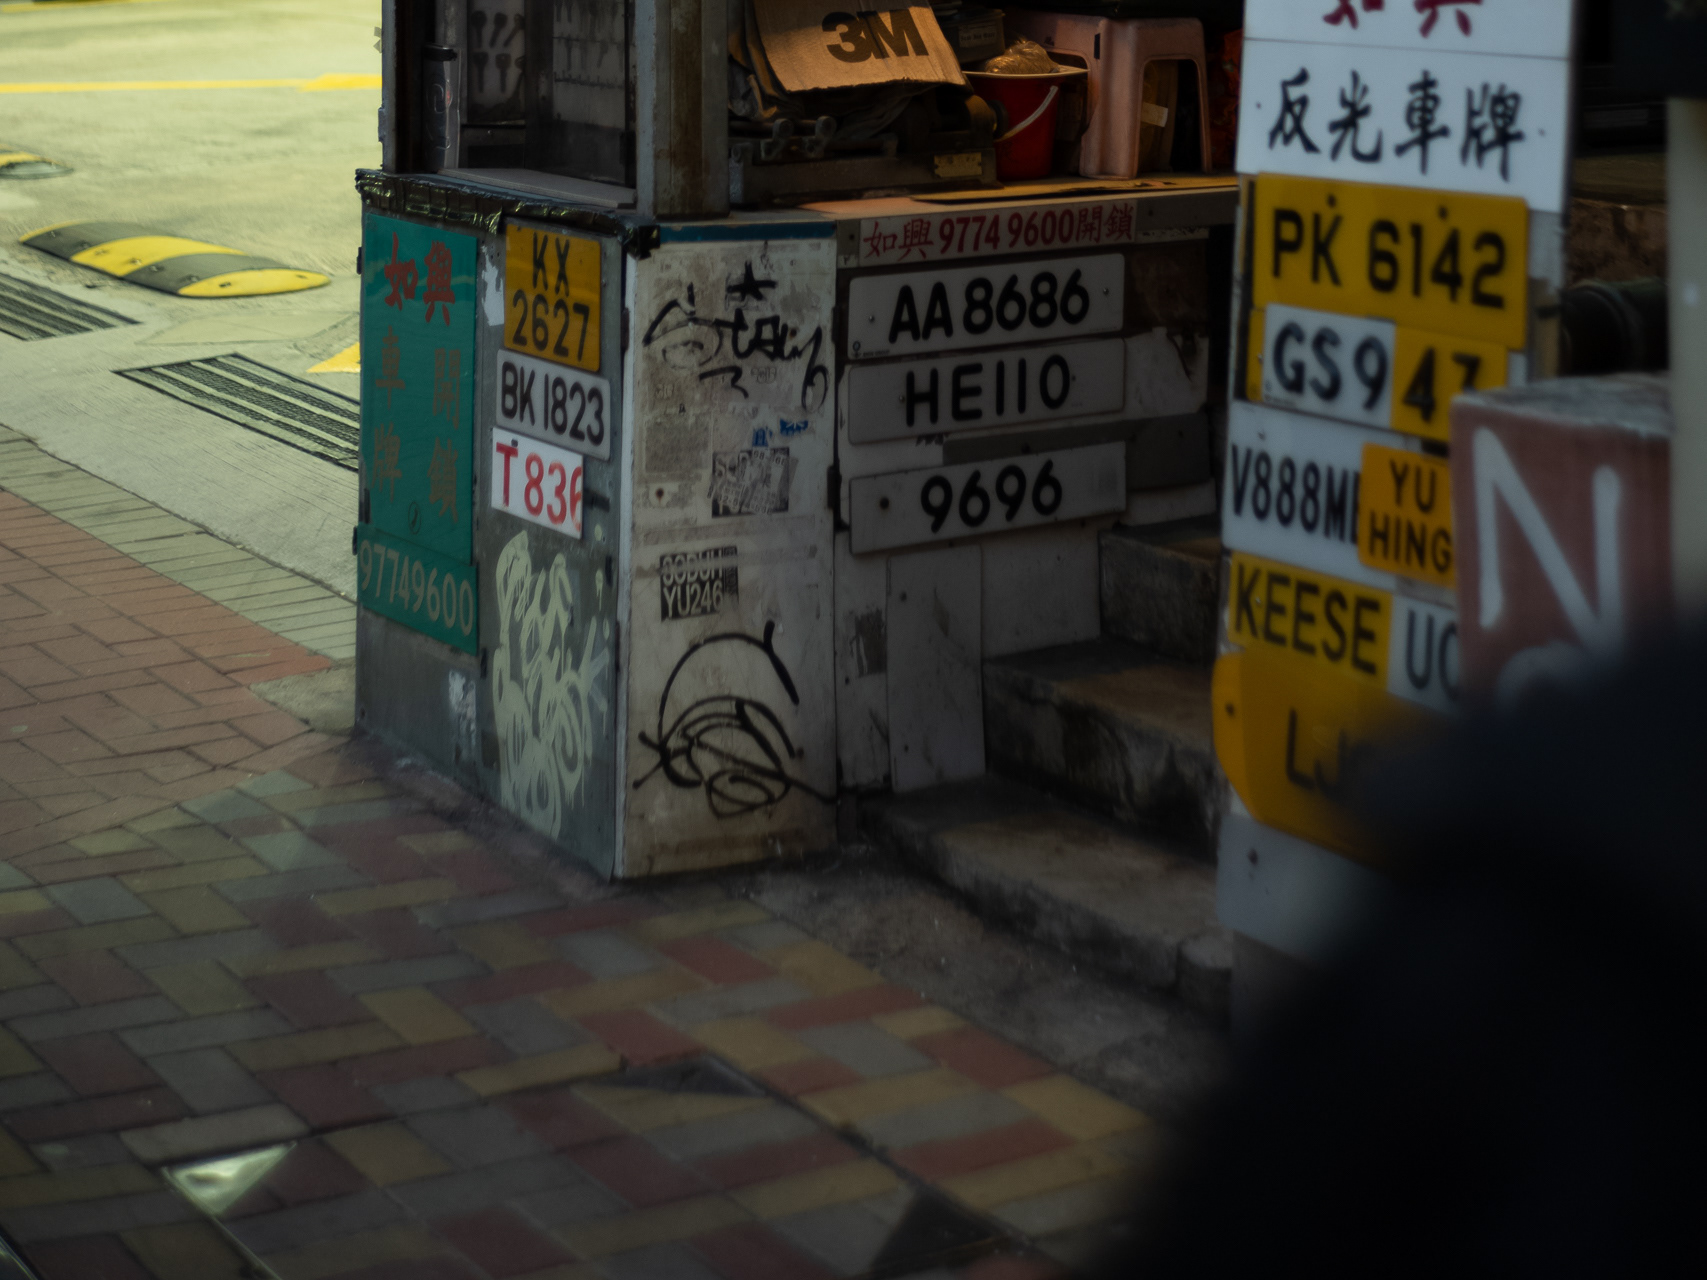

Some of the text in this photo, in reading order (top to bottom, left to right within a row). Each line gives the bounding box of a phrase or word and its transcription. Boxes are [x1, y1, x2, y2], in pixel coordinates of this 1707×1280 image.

[822, 5, 929, 63] 3M
[1269, 67, 1526, 182] 反光車牌
[532, 232, 570, 297] KX
[863, 202, 1135, 262] 如興 9774 9600 開鎖
[1273, 208, 1505, 309] PK 6142
[384, 231, 456, 327] 如興
[512, 288, 591, 362] 2627
[543, 372, 605, 447] 1823
[921, 460, 1062, 533] 9696
[1231, 444, 1361, 545] V888M
[1388, 459, 1436, 513] YU
[1368, 513, 1451, 574] HING
[359, 538, 475, 637] 97749600
[663, 580, 724, 619] YU246
[1232, 564, 1377, 676] KEESE
